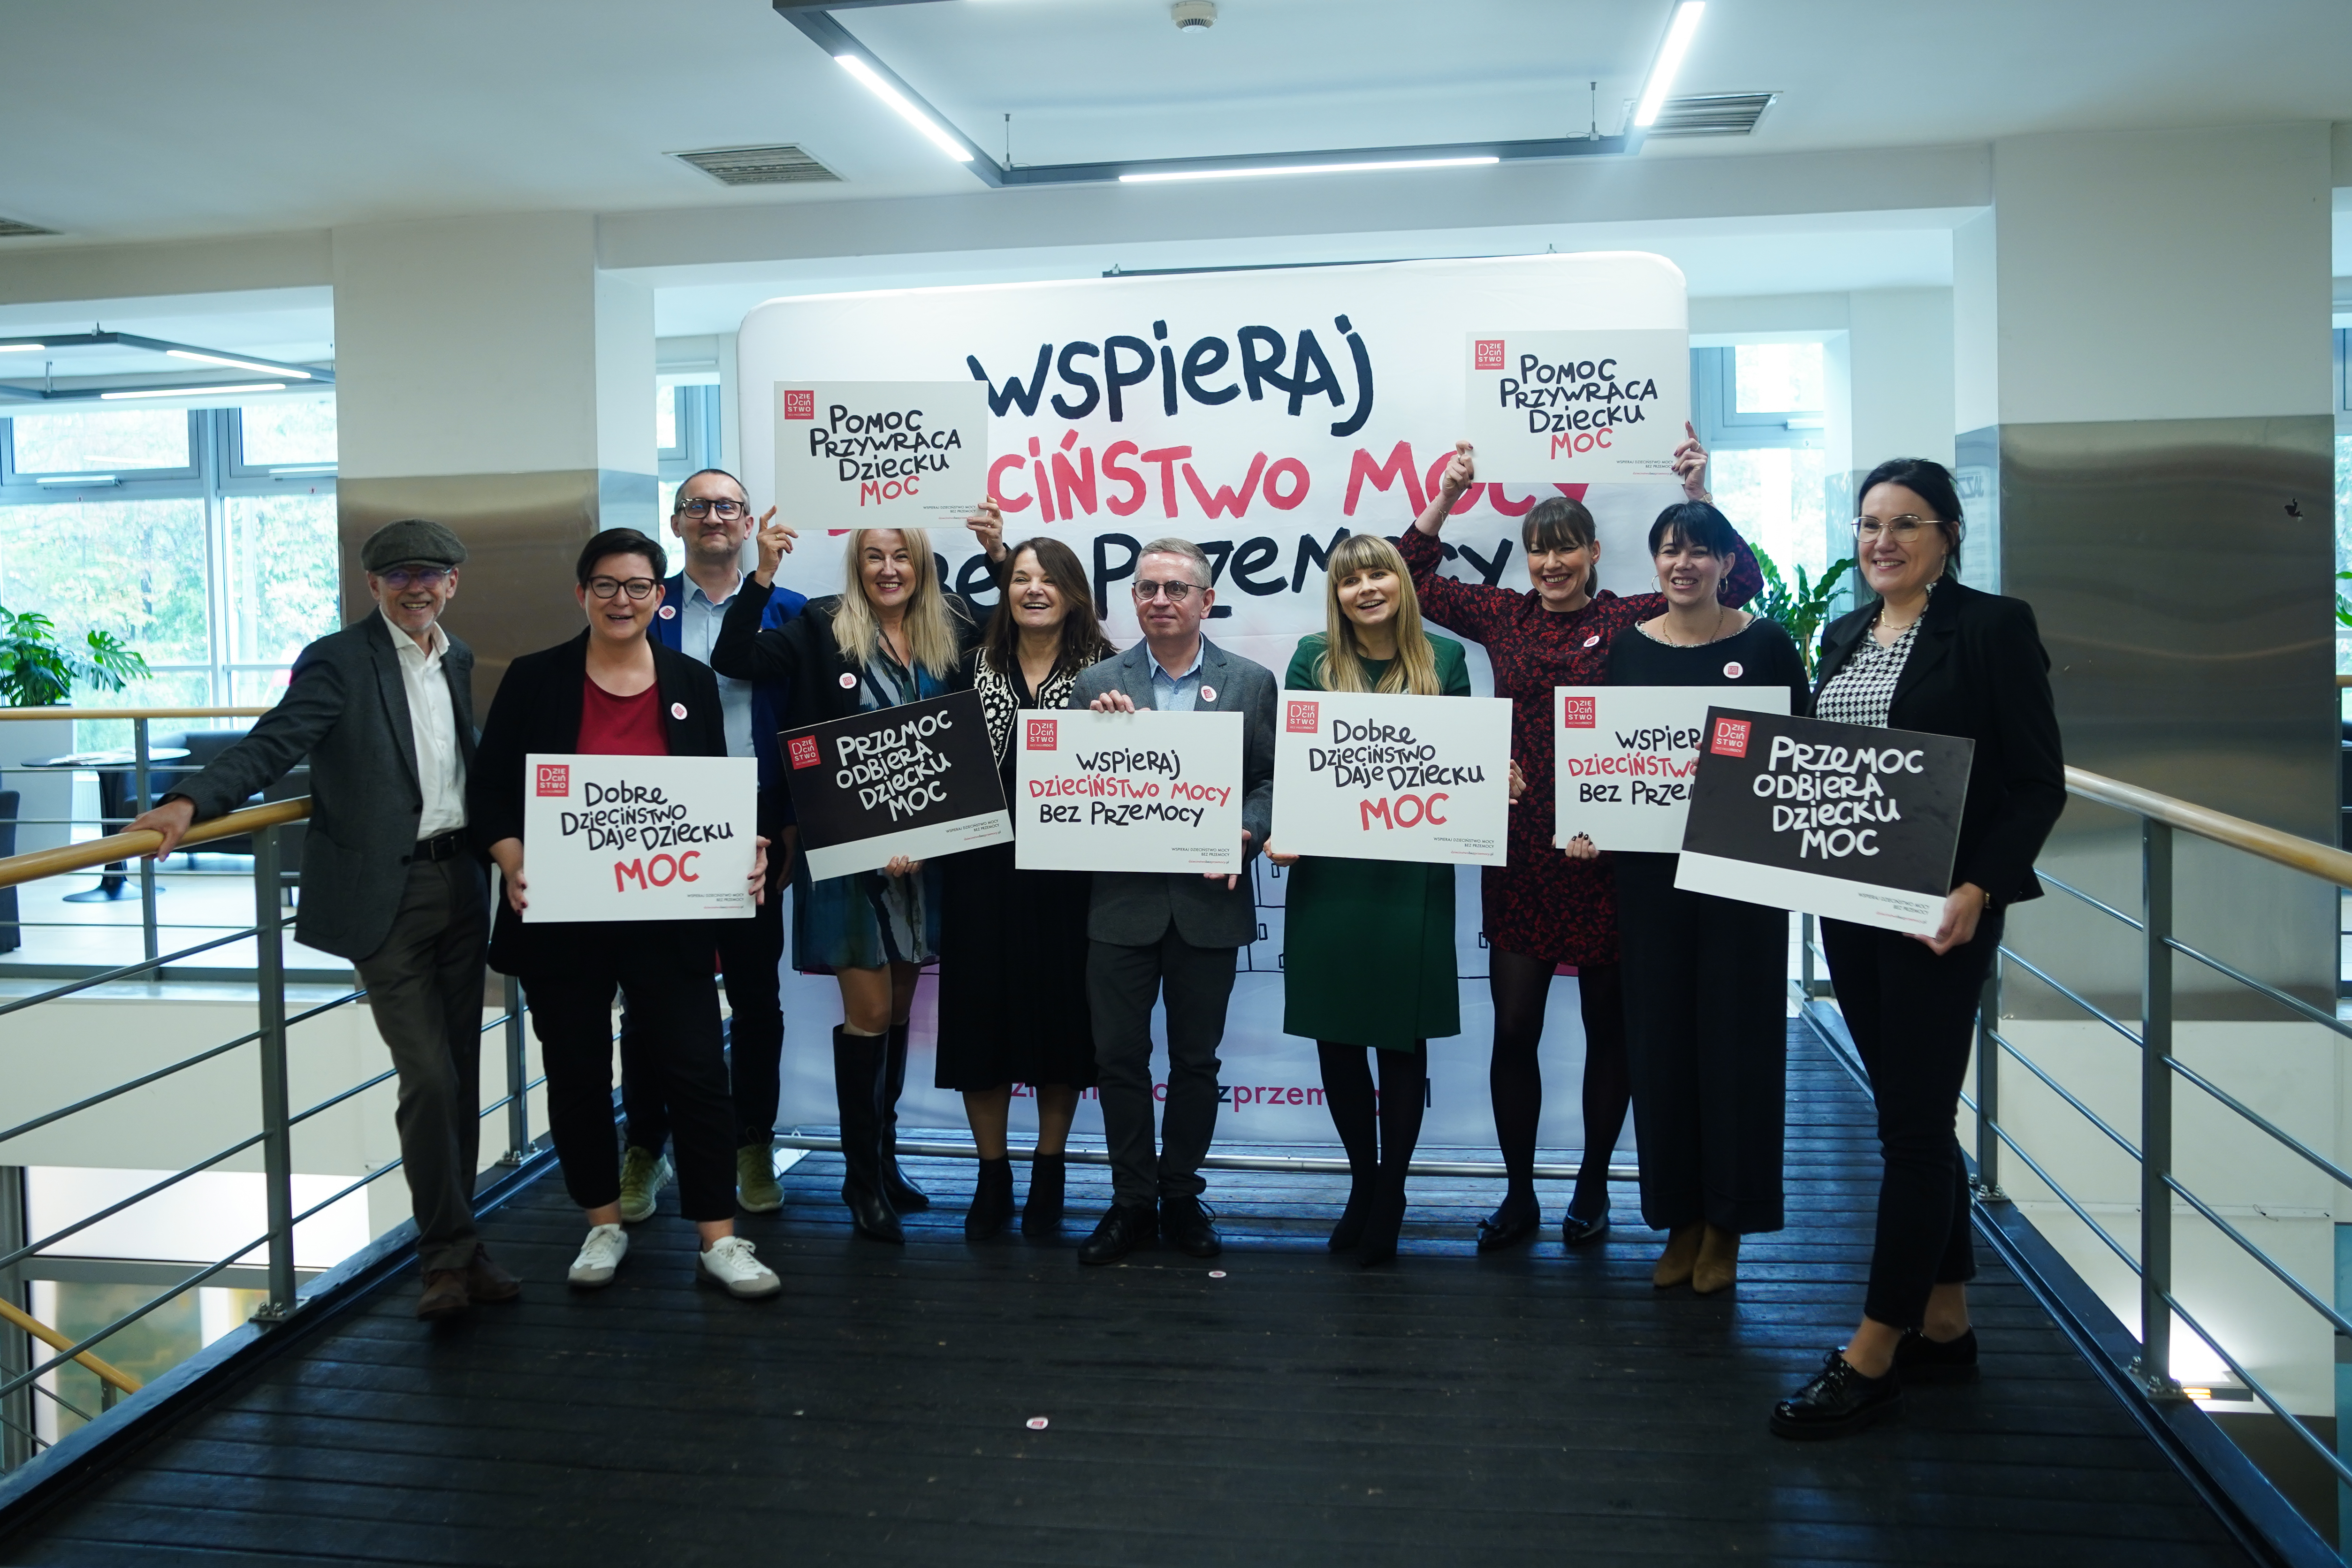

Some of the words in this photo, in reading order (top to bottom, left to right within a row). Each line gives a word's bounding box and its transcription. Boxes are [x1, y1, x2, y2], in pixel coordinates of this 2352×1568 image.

[1551, 427, 1613, 459] MOC
[860, 475, 920, 506] MOC
[794, 752, 816, 761] STWO
[1716, 738, 1743, 747] STWO
[888, 781, 947, 822] MOC
[1171, 782, 1231, 807] MOCY
[1360, 792, 1450, 831] MOC
[1800, 829, 1880, 860] MOC
[614, 851, 701, 892] MOC
